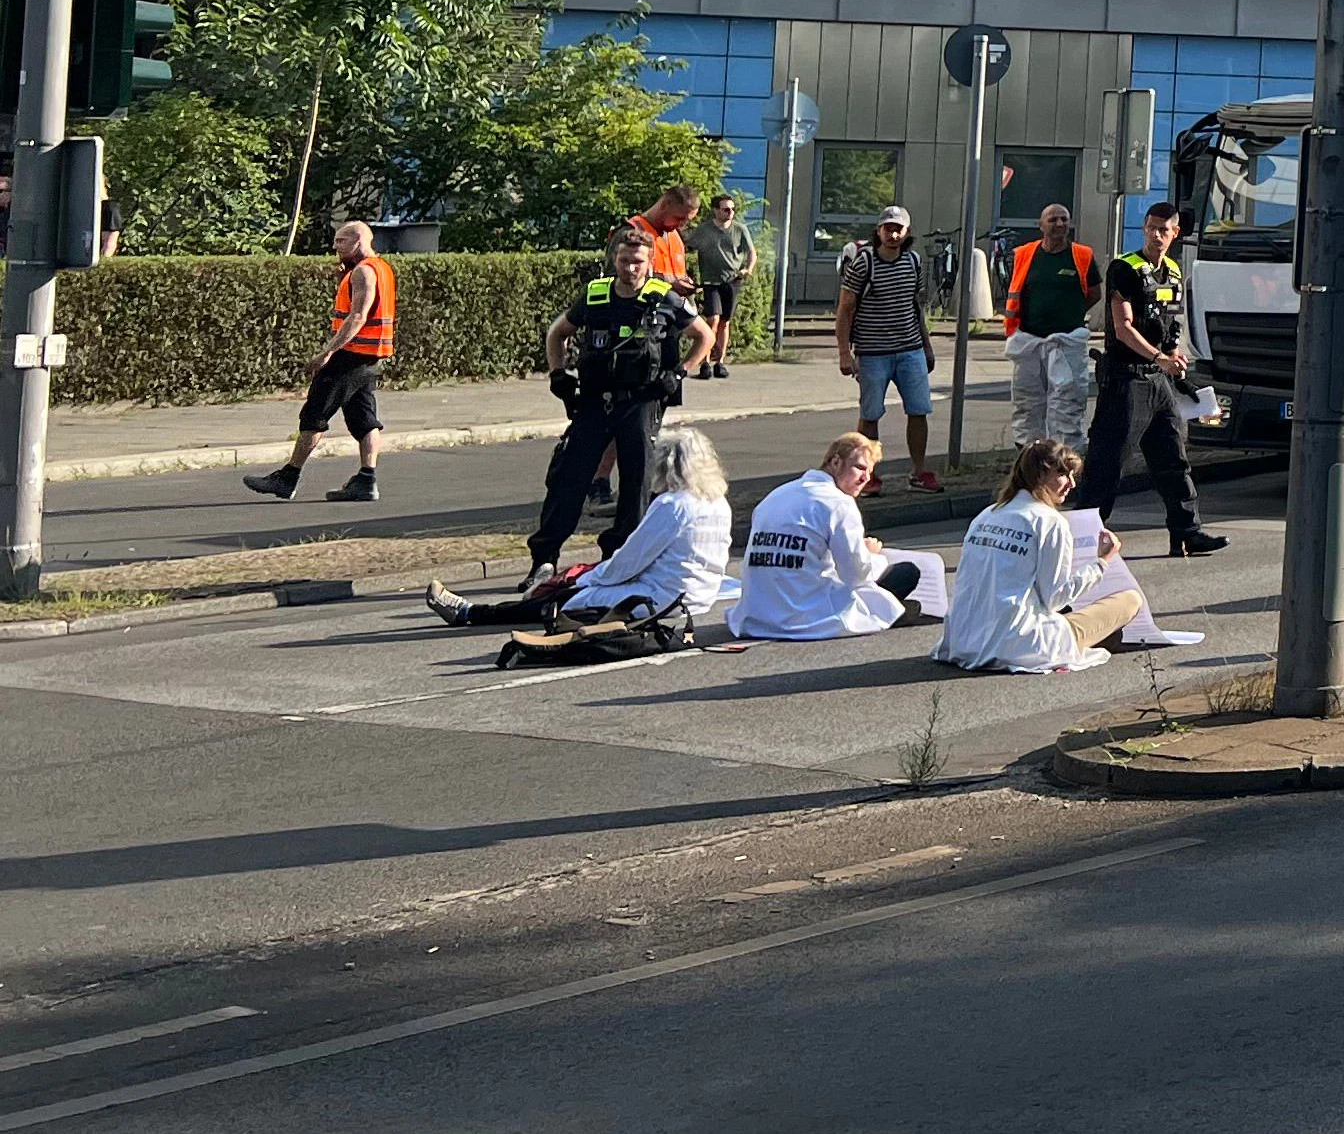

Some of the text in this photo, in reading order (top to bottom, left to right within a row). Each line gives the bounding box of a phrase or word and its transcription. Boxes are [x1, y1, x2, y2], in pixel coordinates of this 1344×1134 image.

[751, 531, 809, 552] SCIENTIST
[976, 523, 1033, 543] SCIENTIST
[968, 535, 1029, 557] REBELLION
